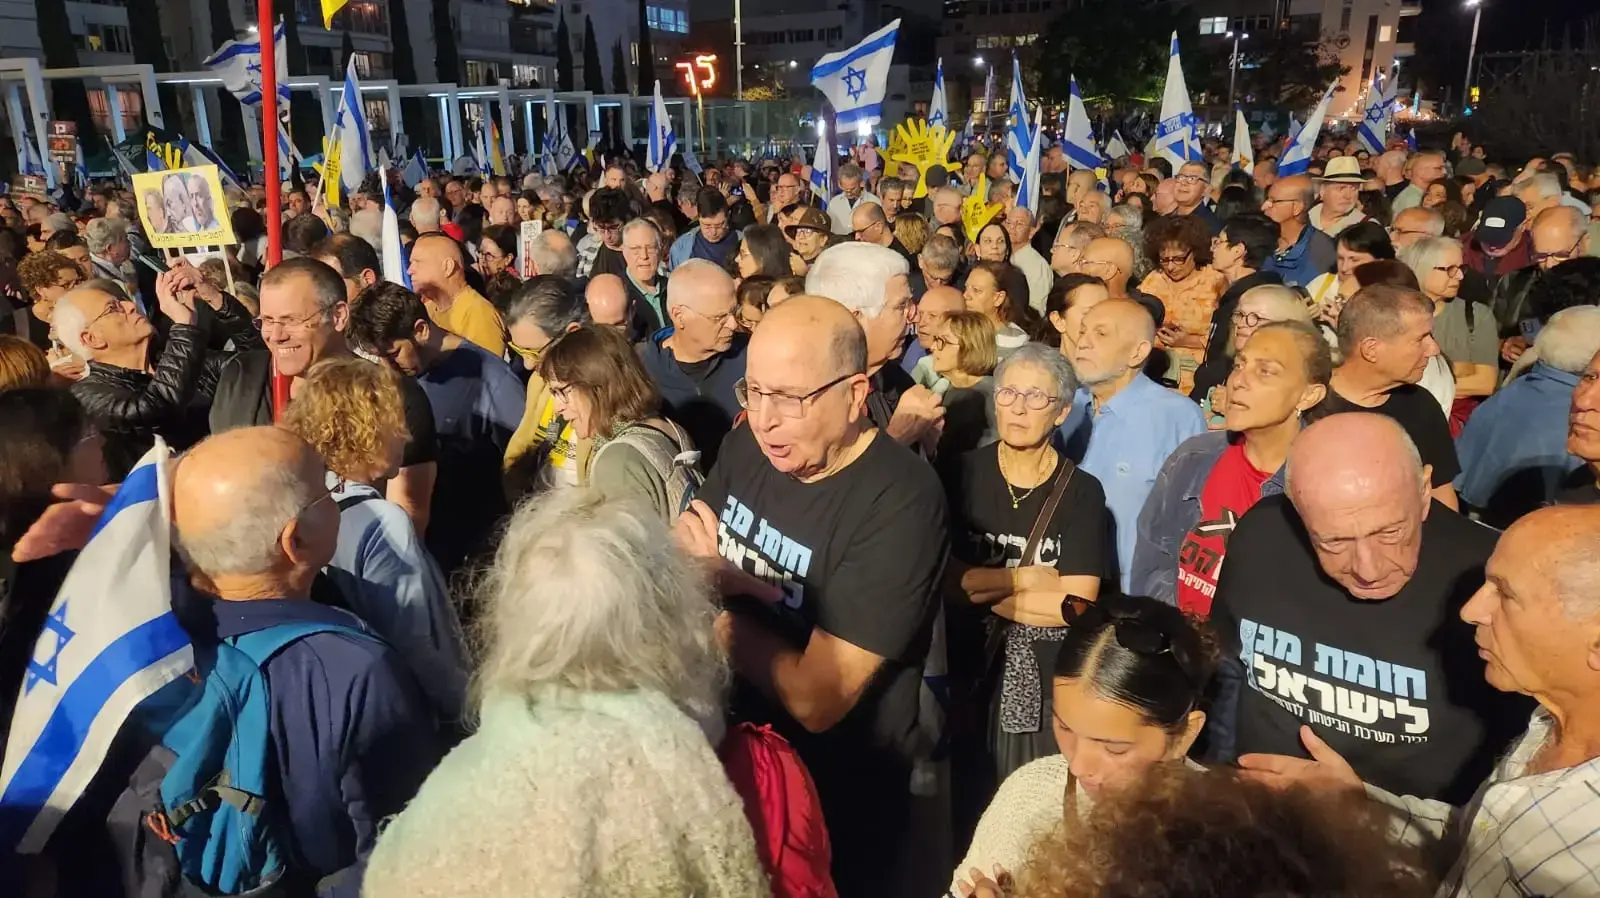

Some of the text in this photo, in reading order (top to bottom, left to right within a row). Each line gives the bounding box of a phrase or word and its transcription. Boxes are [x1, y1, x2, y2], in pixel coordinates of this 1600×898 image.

[722, 494, 754, 538] מג
[1240, 618, 1427, 700] חומת מגן
[1254, 653, 1430, 734] לישראל
[1308, 709, 1351, 734] הביטחון
[1354, 725, 1395, 744] מערכת
